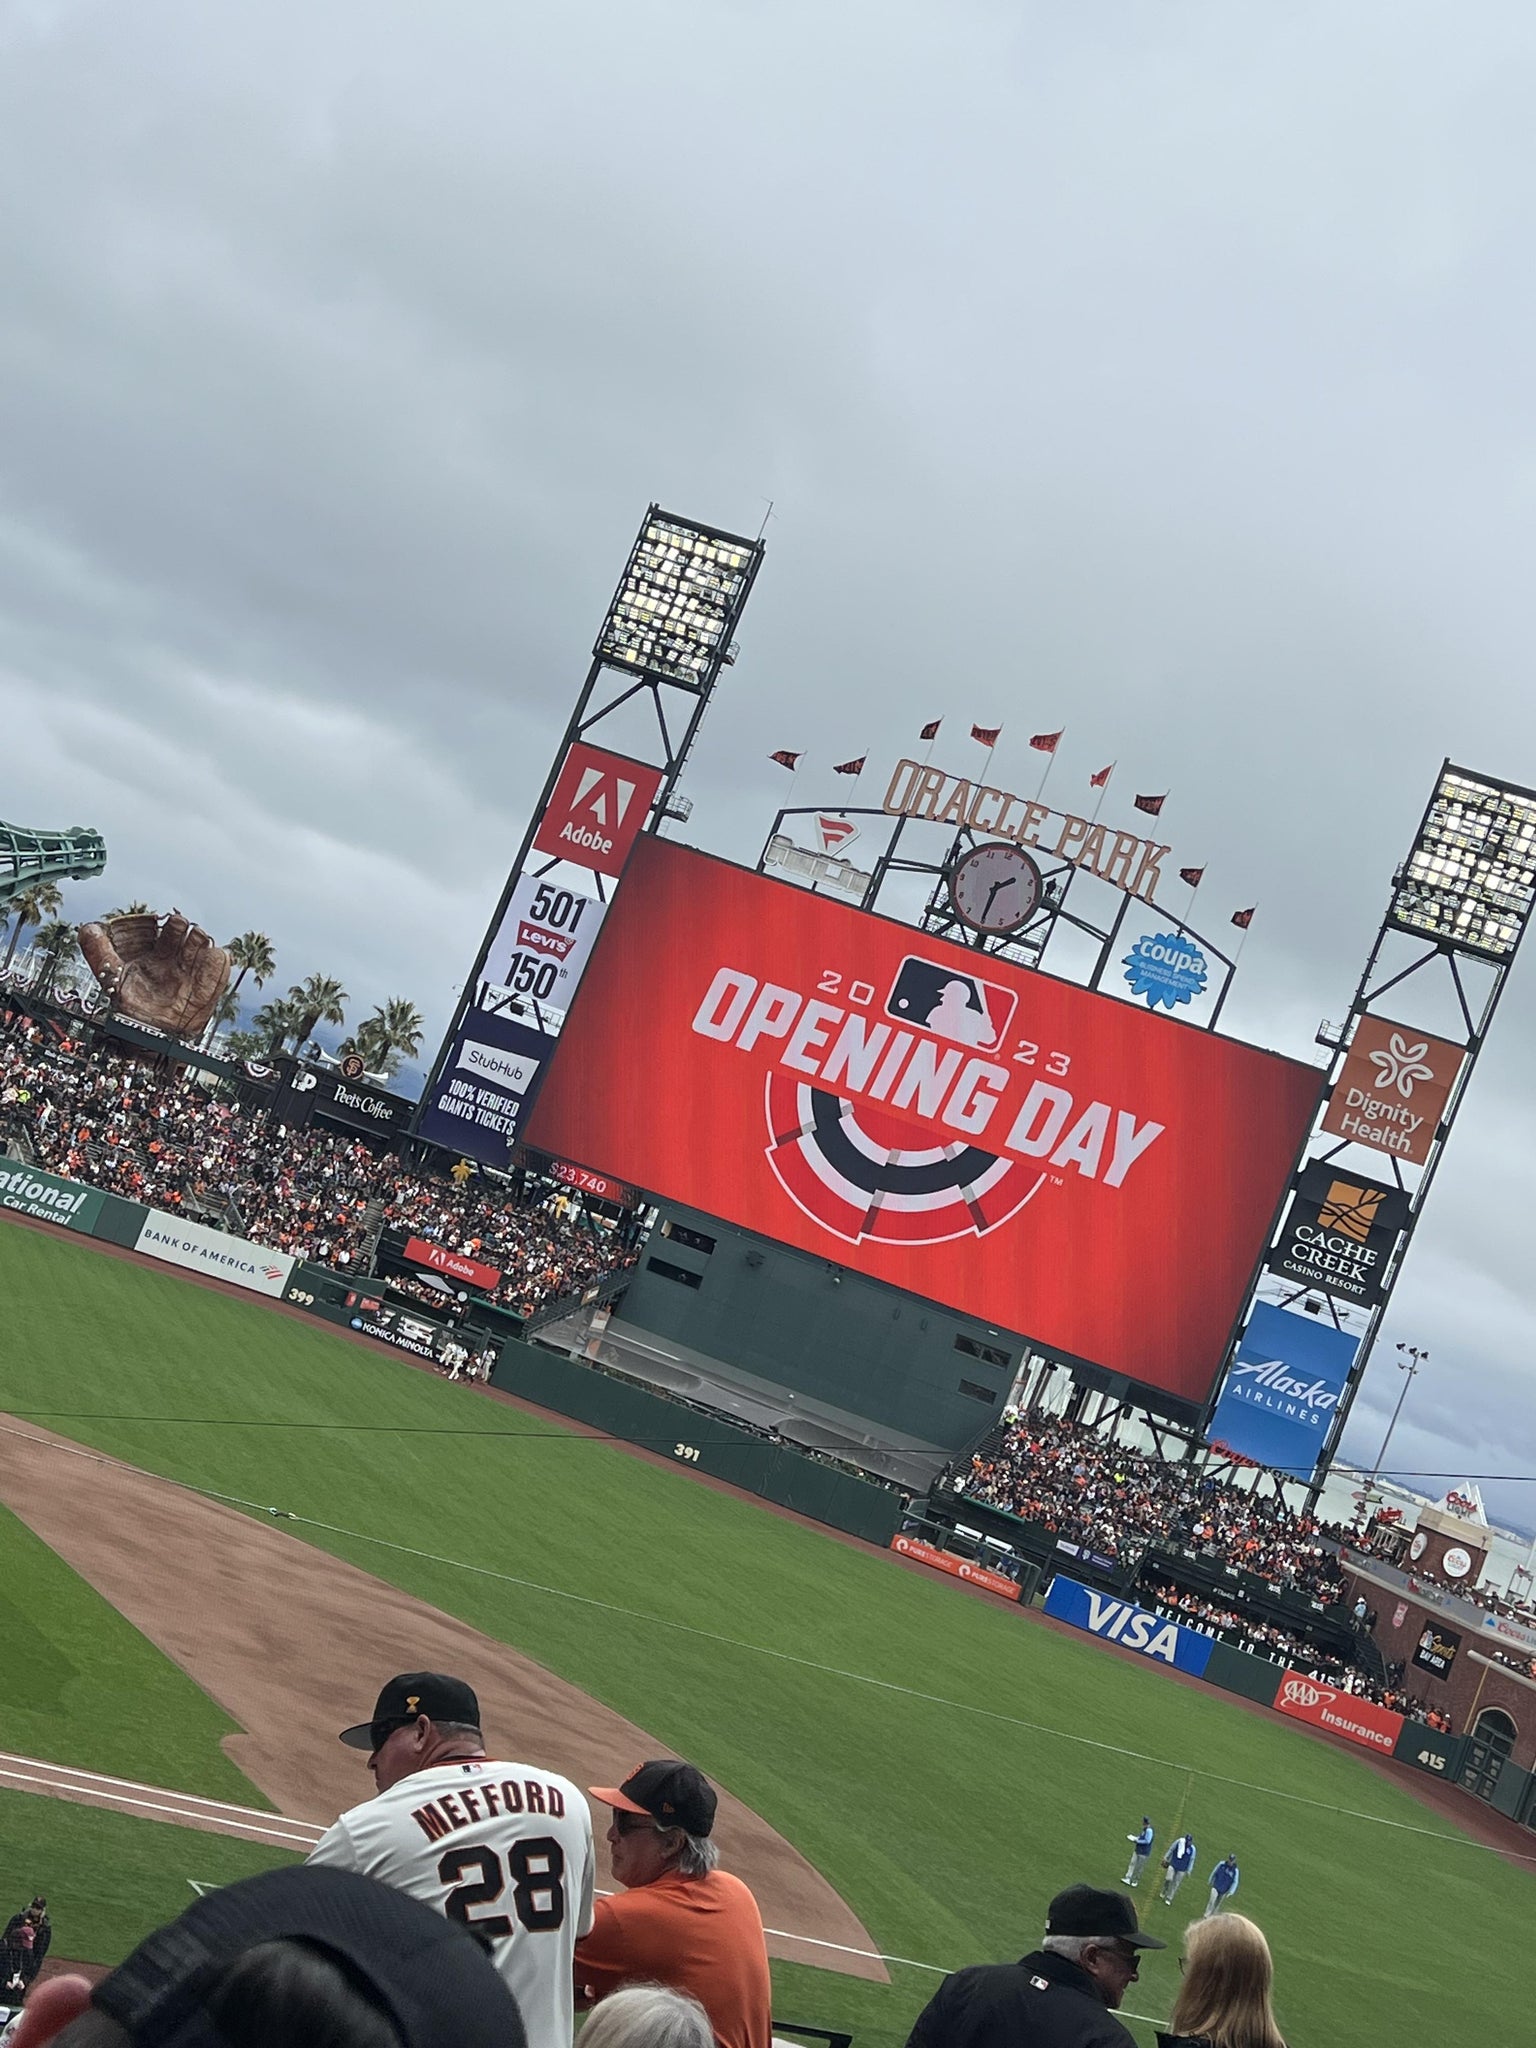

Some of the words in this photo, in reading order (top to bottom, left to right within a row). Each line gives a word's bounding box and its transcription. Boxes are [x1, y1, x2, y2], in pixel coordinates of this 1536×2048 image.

[560, 822, 614, 855] Adobe
[883, 759, 1050, 847] ORACLE
[1053, 814, 1172, 903] PARK
[529, 882, 588, 934] 501
[1140, 941, 1205, 976] coupa
[817, 970, 876, 1006] 20
[468, 1050, 523, 1080] StubHub
[692, 967, 1011, 1136] OPENING
[1004, 1080, 1166, 1188] DAY
[1013, 1040, 1072, 1077] 23
[361, 1097, 393, 1119] Coffee
[438, 1094, 475, 1121] GIANTS
[474, 1110, 517, 1136] TICKETS
[448, 1078, 476, 1102] 100%
[475, 1088, 520, 1118] VERIFIED
[1345, 1087, 1424, 1133] Dignity
[1340, 1113, 1411, 1153] Health
[0, 1171, 87, 1213] ational
[3, 1195, 27, 1210] Car
[26, 1203, 72, 1225] Rental
[144, 1229, 180, 1247] BANK
[182, 1242, 199, 1254] OF
[199, 1248, 256, 1274] AMERICA
[1290, 1242, 1367, 1283] CREEK
[1295, 1224, 1379, 1267] CACHE
[446, 1258, 475, 1278] Adobe
[1282, 1258, 1323, 1281] CASINO
[1324, 1275, 1367, 1295] RESORT
[289, 1288, 314, 1306] 399
[362, 1323, 396, 1343] KONICA
[396, 1336, 433, 1358] MINOLTA
[1232, 1383, 1320, 1426] AIRLINES
[1233, 1359, 1338, 1410] Alaska
[674, 1443, 700, 1464] 391
[1083, 1588, 1179, 1663] VISA
[1155, 1604, 1225, 1642] WELCOME
[1238, 1639, 1255, 1655] TO
[1268, 1651, 1295, 1670] THE
[1307, 1669, 1336, 1688] 415
[1285, 1682, 1318, 1706] AAA
[1320, 1708, 1393, 1747] Insurance
[1417, 1750, 1447, 1771] 415
[411, 1780, 565, 1842] MEFFORD
[437, 1836, 565, 1937] 28
